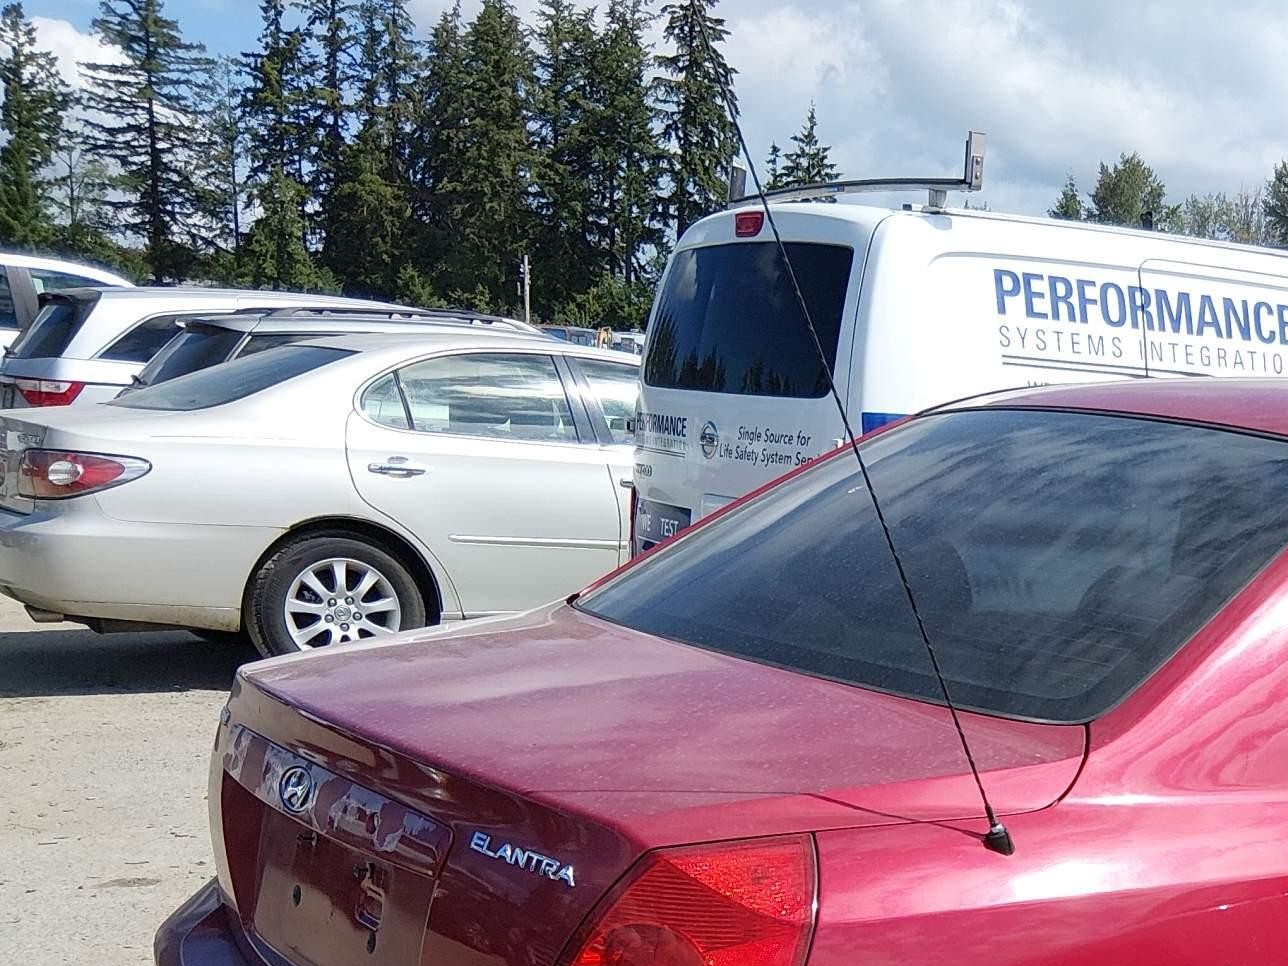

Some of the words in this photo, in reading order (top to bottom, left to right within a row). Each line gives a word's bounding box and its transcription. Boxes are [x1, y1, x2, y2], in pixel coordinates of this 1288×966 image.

[999, 325, 1123, 358] SYSTEMS
[636, 412, 687, 437] PERFORMANCE
[738, 426, 762, 445] Single
[764, 428, 794, 446] Source
[796, 430, 812, 447] for
[720, 443, 733, 458] Life
[735, 446, 759, 466] Safety
[761, 448, 792, 467] System
[660, 518, 679, 537] TEST
[470, 831, 576, 888] ELANTRA
